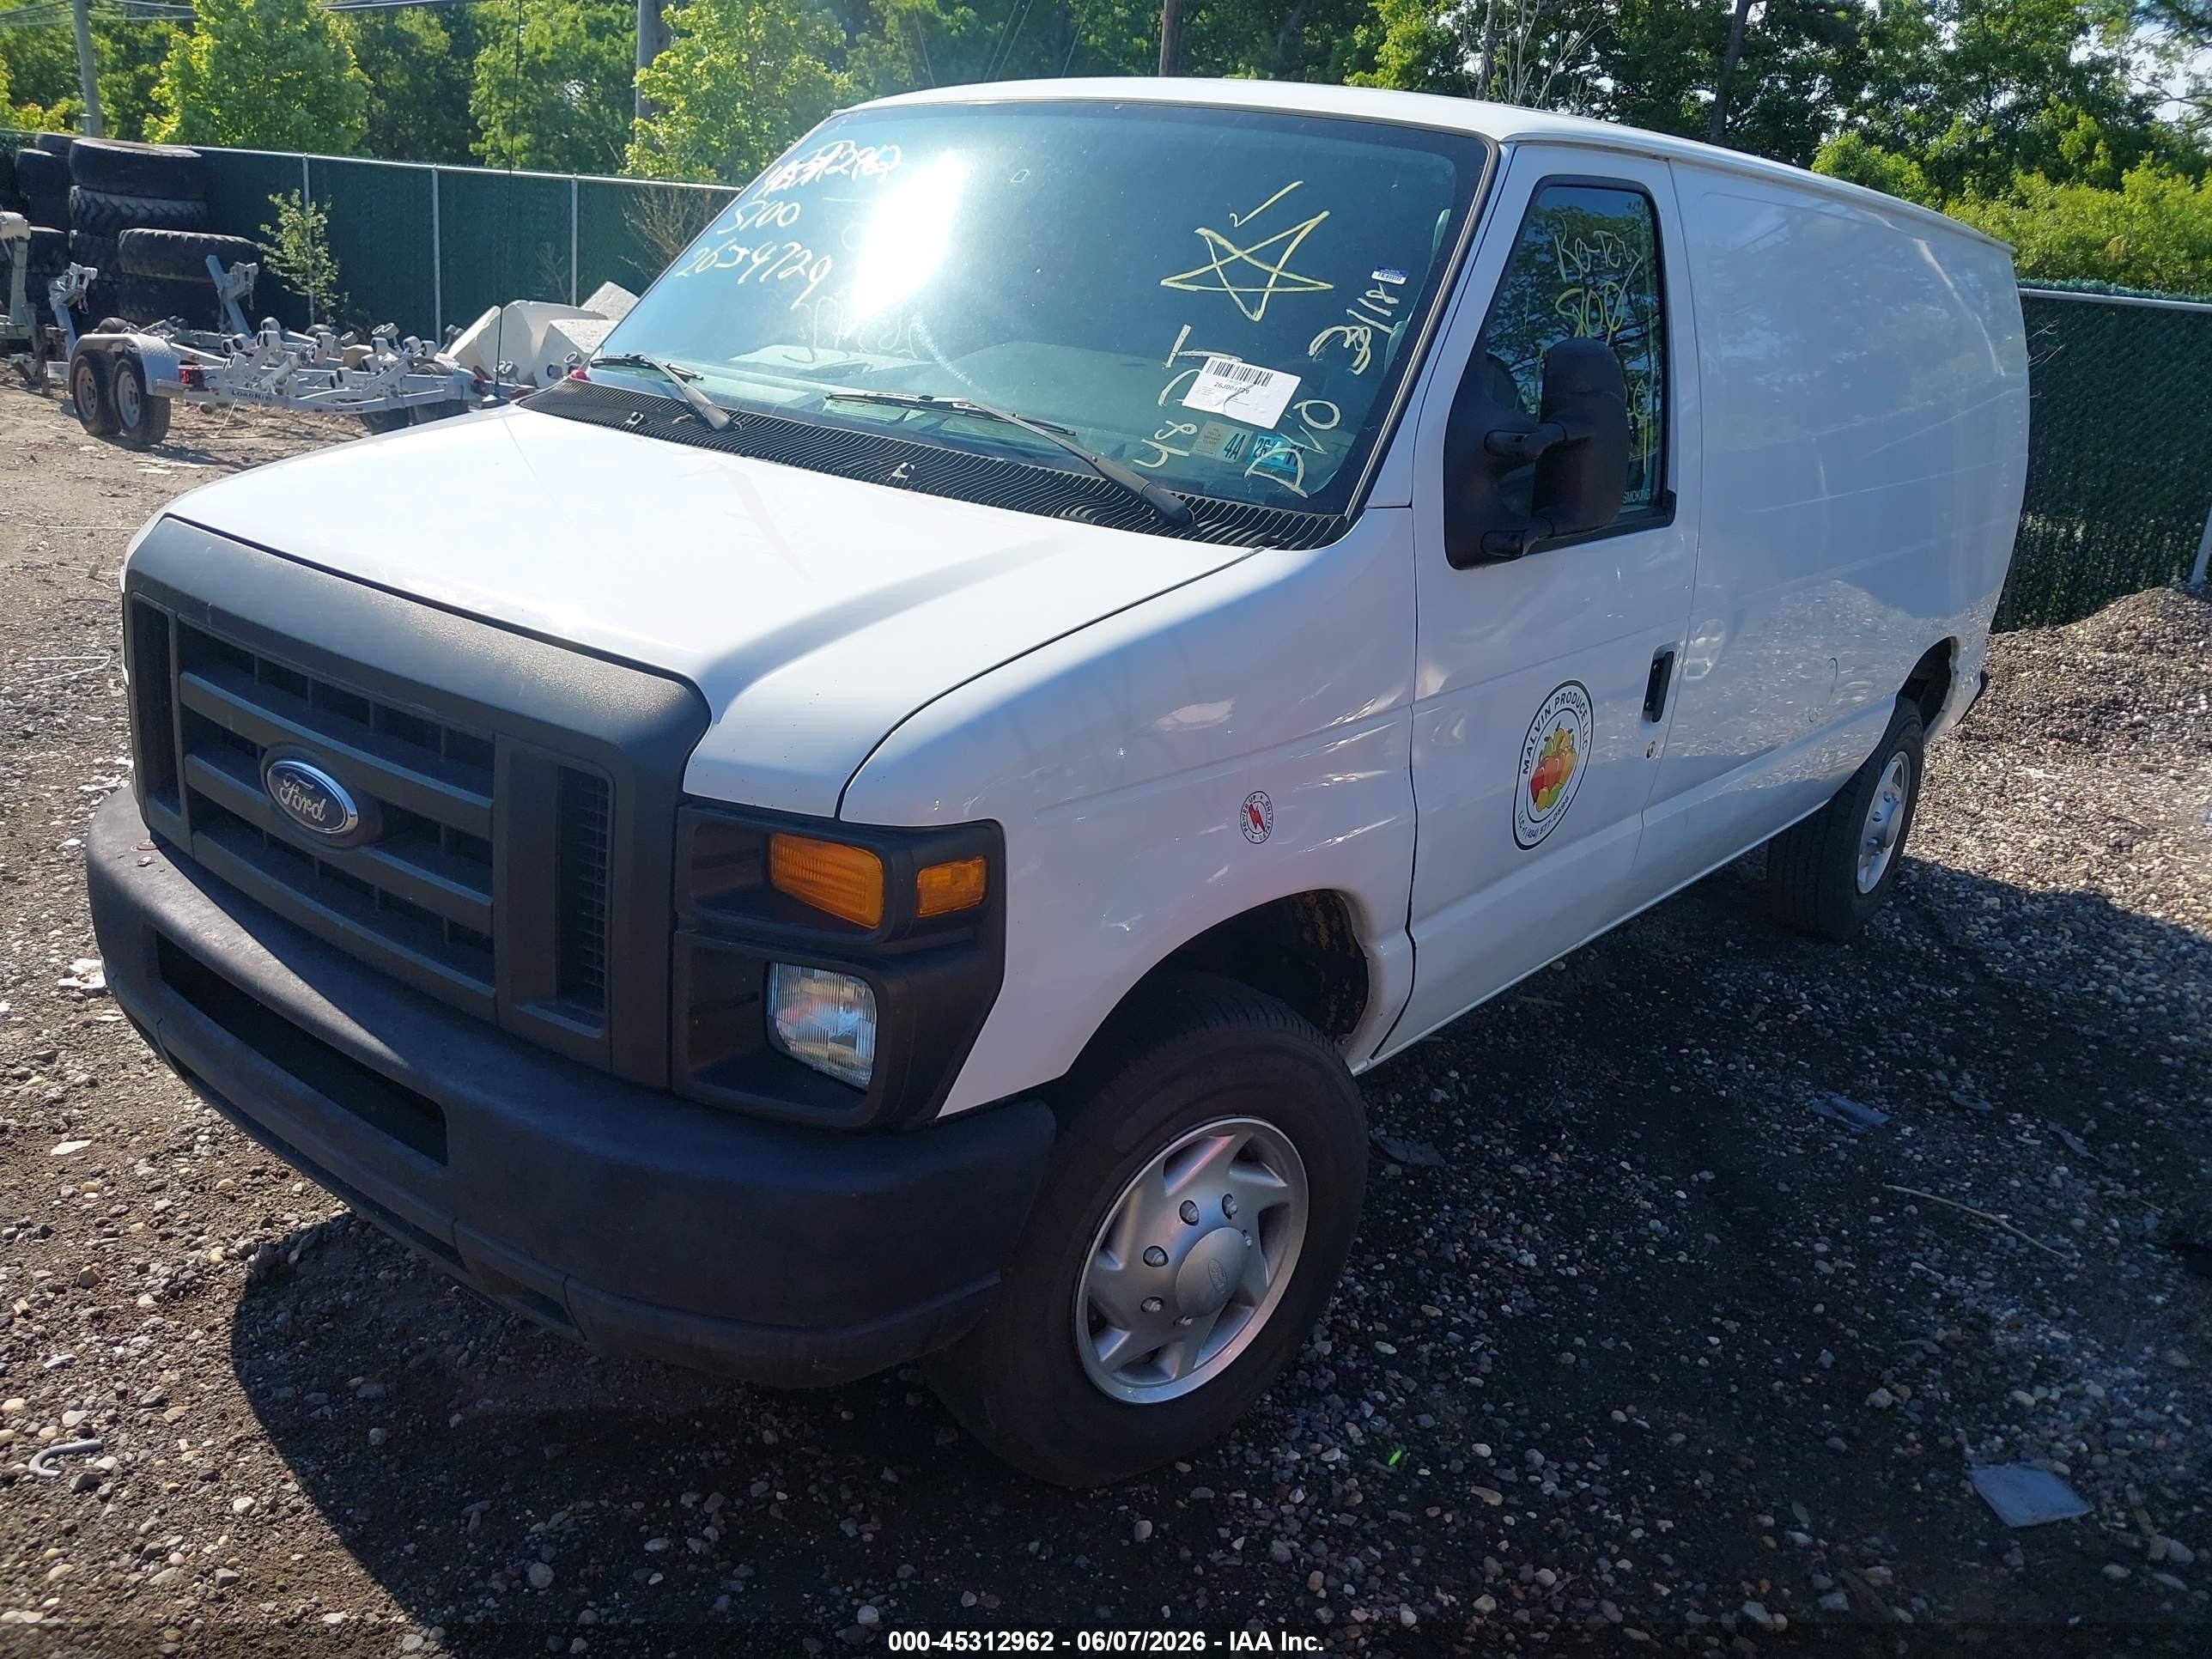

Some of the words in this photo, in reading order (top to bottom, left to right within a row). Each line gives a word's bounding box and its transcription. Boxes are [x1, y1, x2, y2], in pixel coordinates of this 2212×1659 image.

[1522, 704, 1552, 775] MALVIN
[1553, 690, 1589, 722] PRODUCE
[279, 773, 327, 822] Ford
